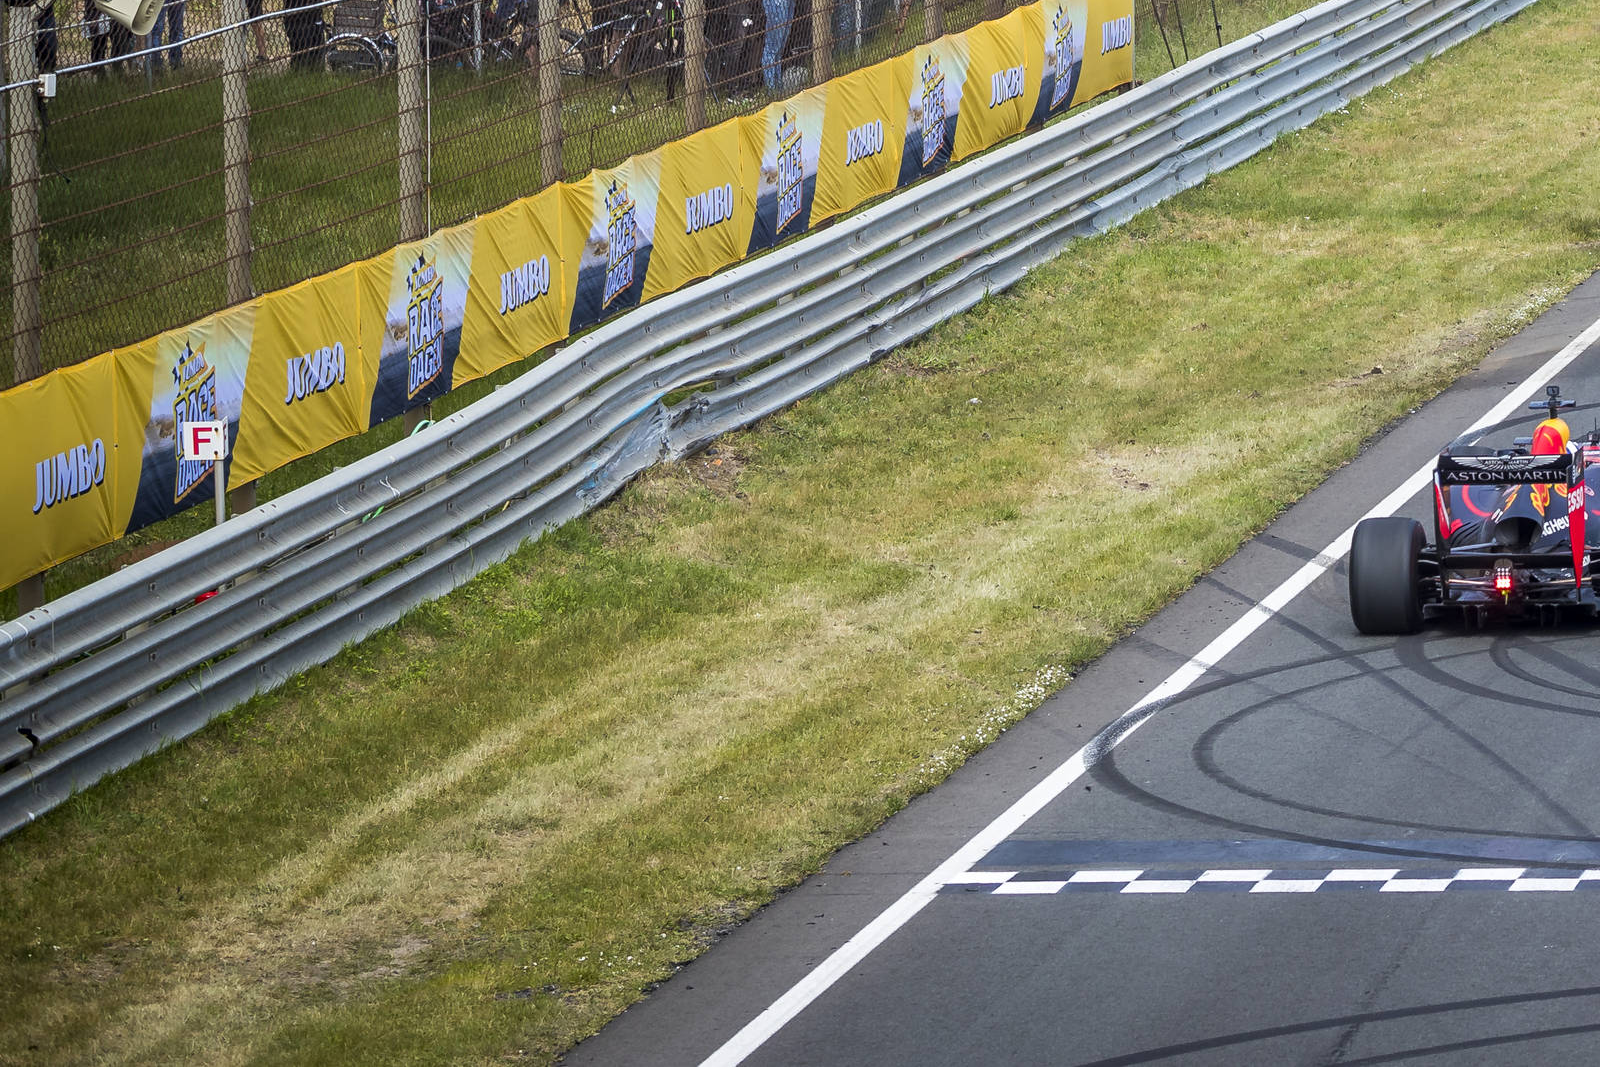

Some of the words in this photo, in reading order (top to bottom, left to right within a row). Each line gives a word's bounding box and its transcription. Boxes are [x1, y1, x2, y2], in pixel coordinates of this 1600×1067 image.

[1101, 14, 1132, 56] JUMBO
[990, 64, 1025, 109] JUMBO
[845, 119, 884, 167] JUMBO
[686, 183, 734, 235] JUMBO
[499, 254, 550, 315] JUMBO
[409, 282, 442, 354] RACE
[285, 341, 346, 406] JUMBO
[192, 427, 213, 456] F
[33, 438, 106, 514] JUMBO
[1447, 471, 1504, 481] ASTON
[1508, 470, 1567, 480] MARTIN
